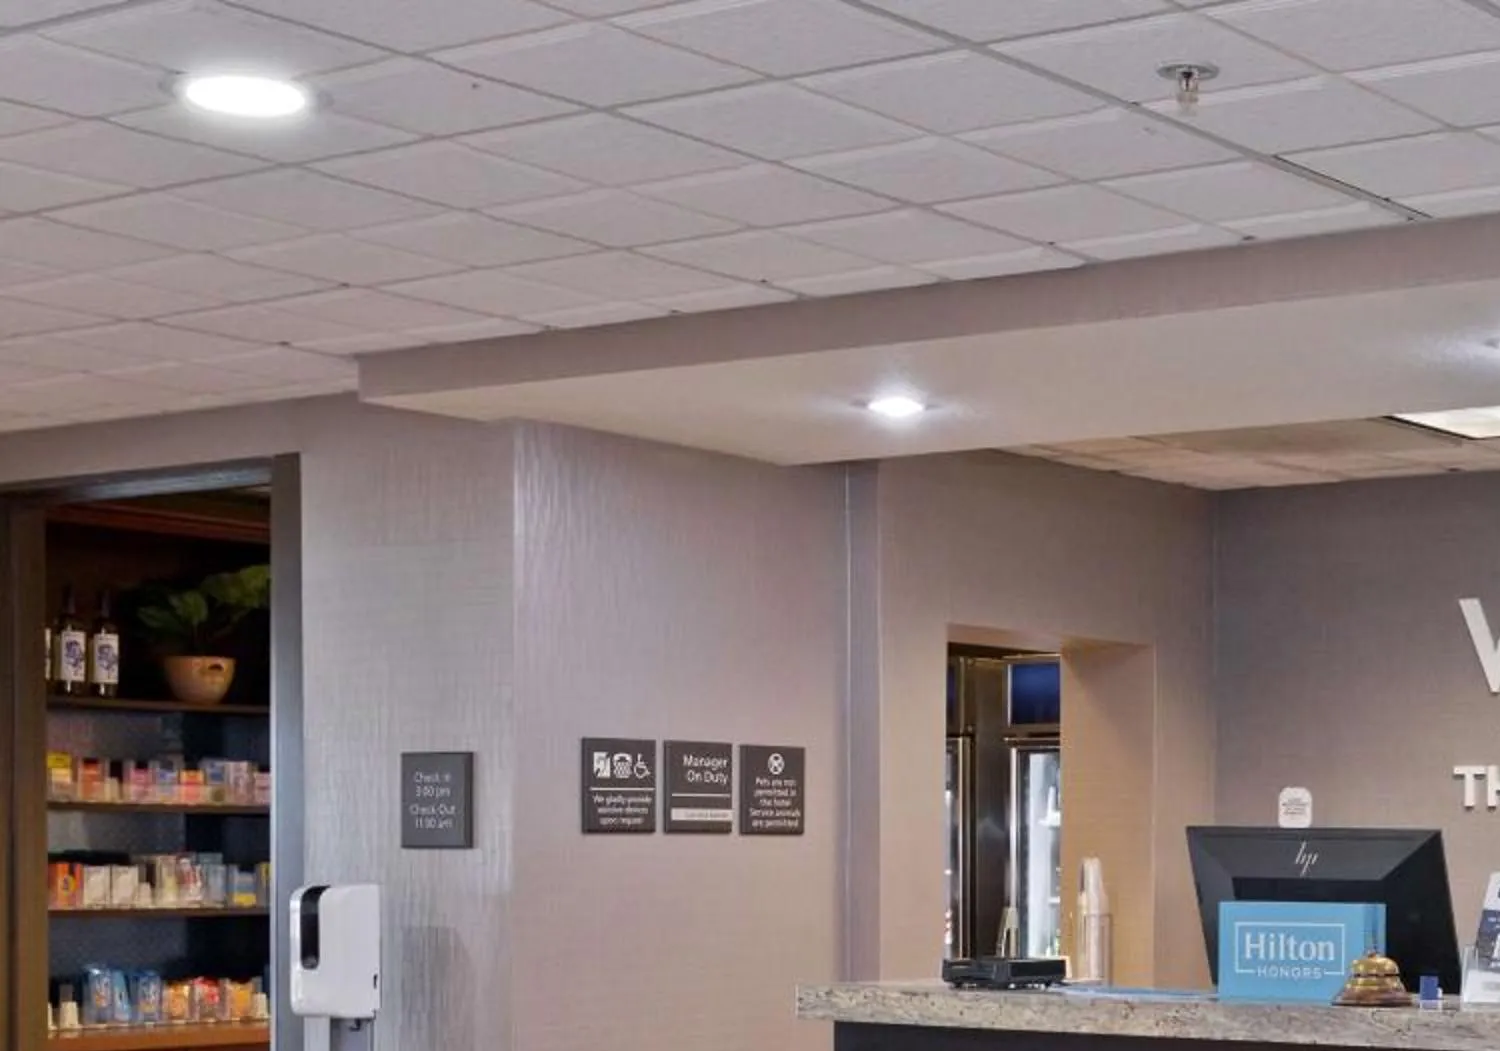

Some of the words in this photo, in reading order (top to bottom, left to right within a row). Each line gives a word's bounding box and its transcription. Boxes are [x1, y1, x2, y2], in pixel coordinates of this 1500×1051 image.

[682, 753, 729, 772] Manager
[686, 769, 703, 783] On
[704, 771, 729, 785] Duty
[1295, 839, 1320, 877] hp
[1244, 931, 1336, 962] Hilton
[1257, 964, 1323, 980] HONORS
